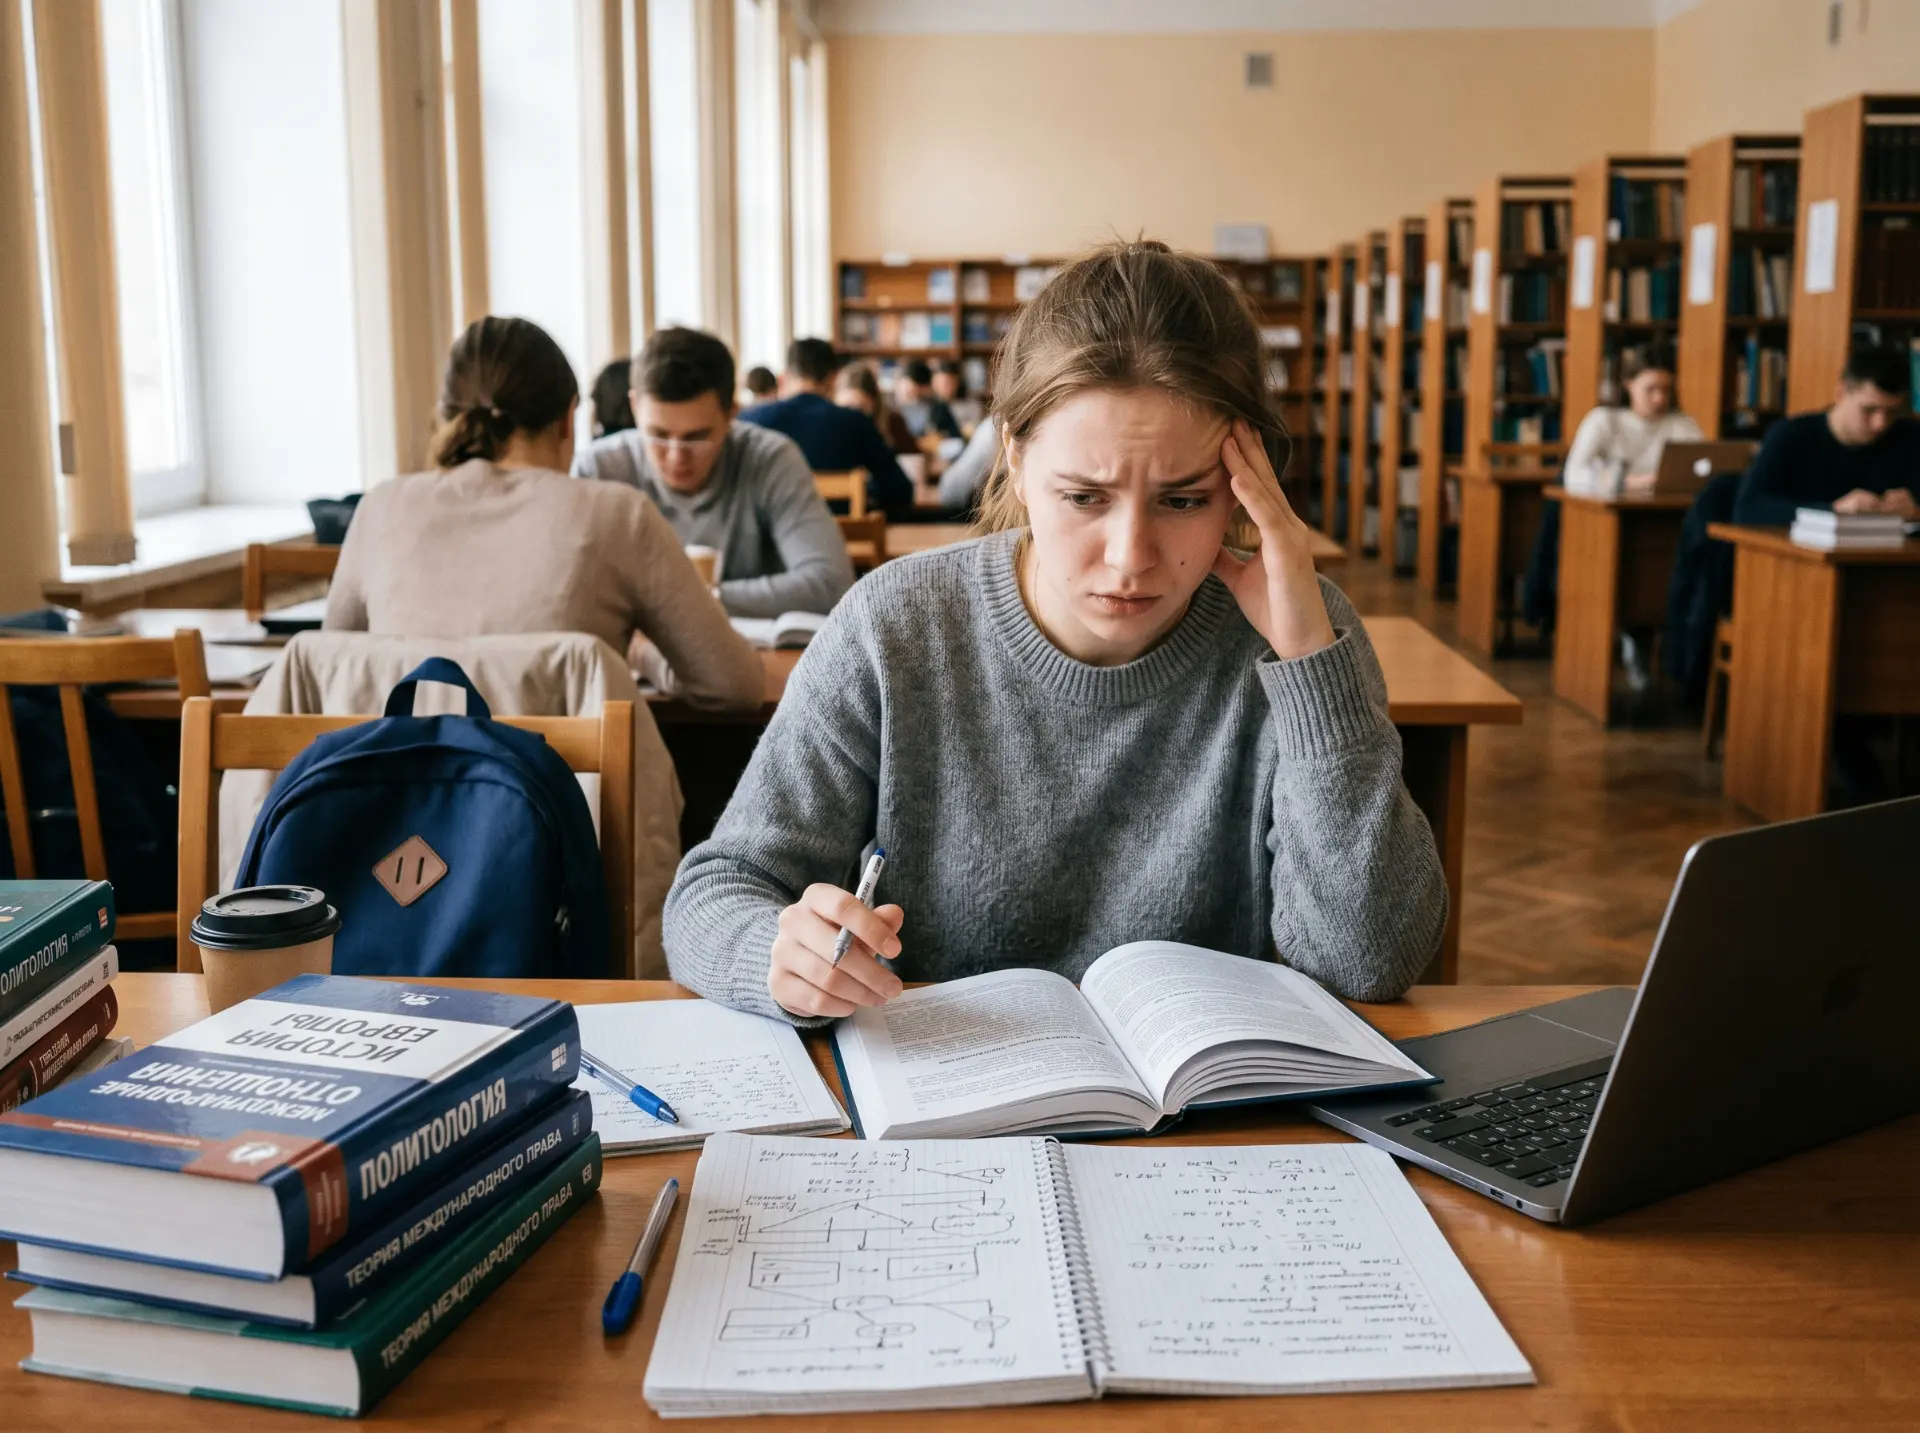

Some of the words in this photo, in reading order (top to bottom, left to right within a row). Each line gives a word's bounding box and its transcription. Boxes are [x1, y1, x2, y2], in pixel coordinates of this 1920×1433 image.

[0, 933, 68, 996] ОЛИТОЛОГИЯ
[226, 1029, 410, 1063] ИСТОРИЯ
[271, 1012, 440, 1043] ЕВРОПЫ
[90, 1080, 336, 1122] МЕЖДУНАРОДНЫЕ
[127, 1061, 362, 1105] ОТНОШЕНИЯ
[359, 1077, 507, 1200] ПОЛИТОЛОГИЯ
[346, 1236, 400, 1288] ТЕОРИЯ
[402, 1153, 524, 1250] МЕЖДУНАРОДНОГО
[526, 1128, 562, 1164] ПРАВА
[380, 1313, 430, 1369] ТЕОРИЯ
[432, 1212, 540, 1323] МЕЖДУНАРОДНОГО
[541, 1182, 573, 1222] ПРАВА
